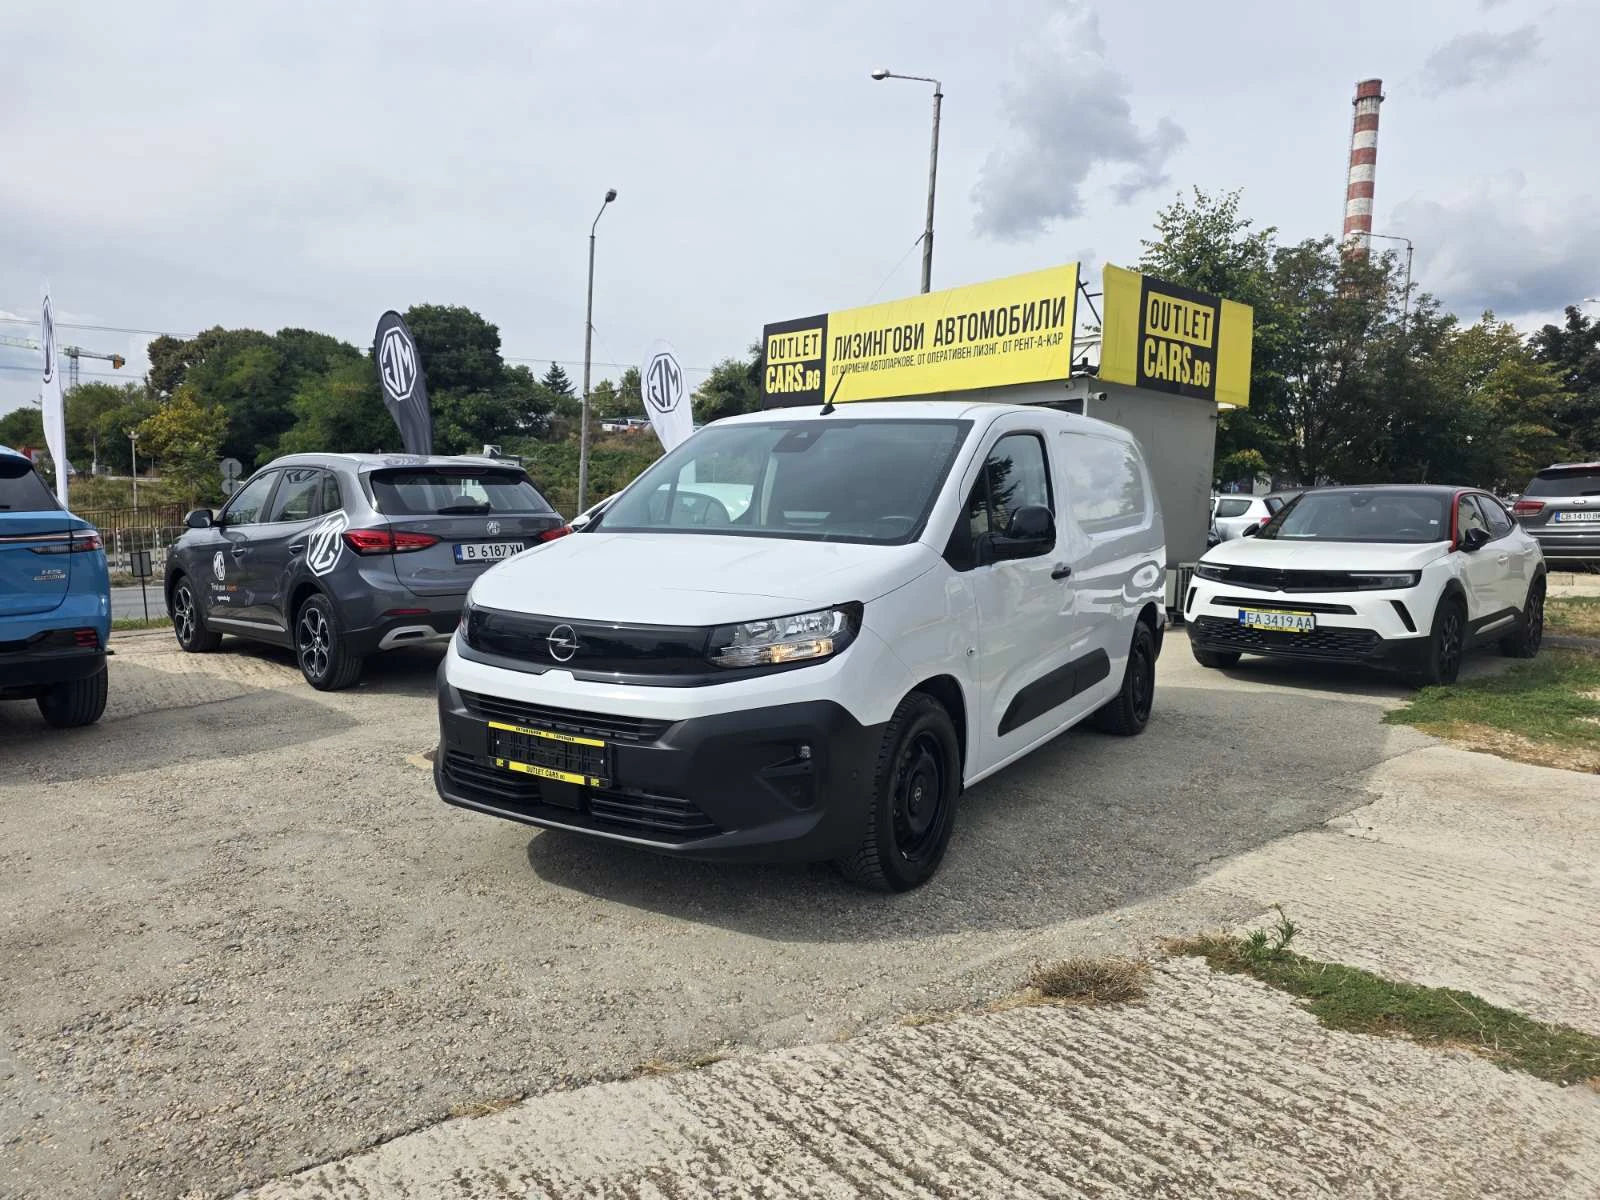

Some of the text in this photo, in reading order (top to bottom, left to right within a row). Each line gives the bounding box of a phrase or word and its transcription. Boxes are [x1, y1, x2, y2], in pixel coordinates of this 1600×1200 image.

[832, 295, 1067, 362] ЛИЗИНГОВИ АВТОМОБИЛИ
[1150, 299, 1211, 341] OUTLET
[770, 333, 820, 360] OUTLET
[831, 365, 839, 376] ОТ
[917, 353, 926, 366] ОТ
[926, 347, 972, 365] ОПЕРАТИВЕН
[1002, 339, 1013, 354] ОТ
[1014, 332, 1064, 353] РЕНТ-А-КАР
[1143, 338, 1211, 388] CARS.BG
[766, 363, 821, 394] CARS.BG
[308, 514, 346, 573] MG
[481, 544, 507, 557] 6187
[1246, 612, 1262, 625] EA
[1263, 614, 1294, 628] 3419
[1295, 617, 1313, 630] AA
